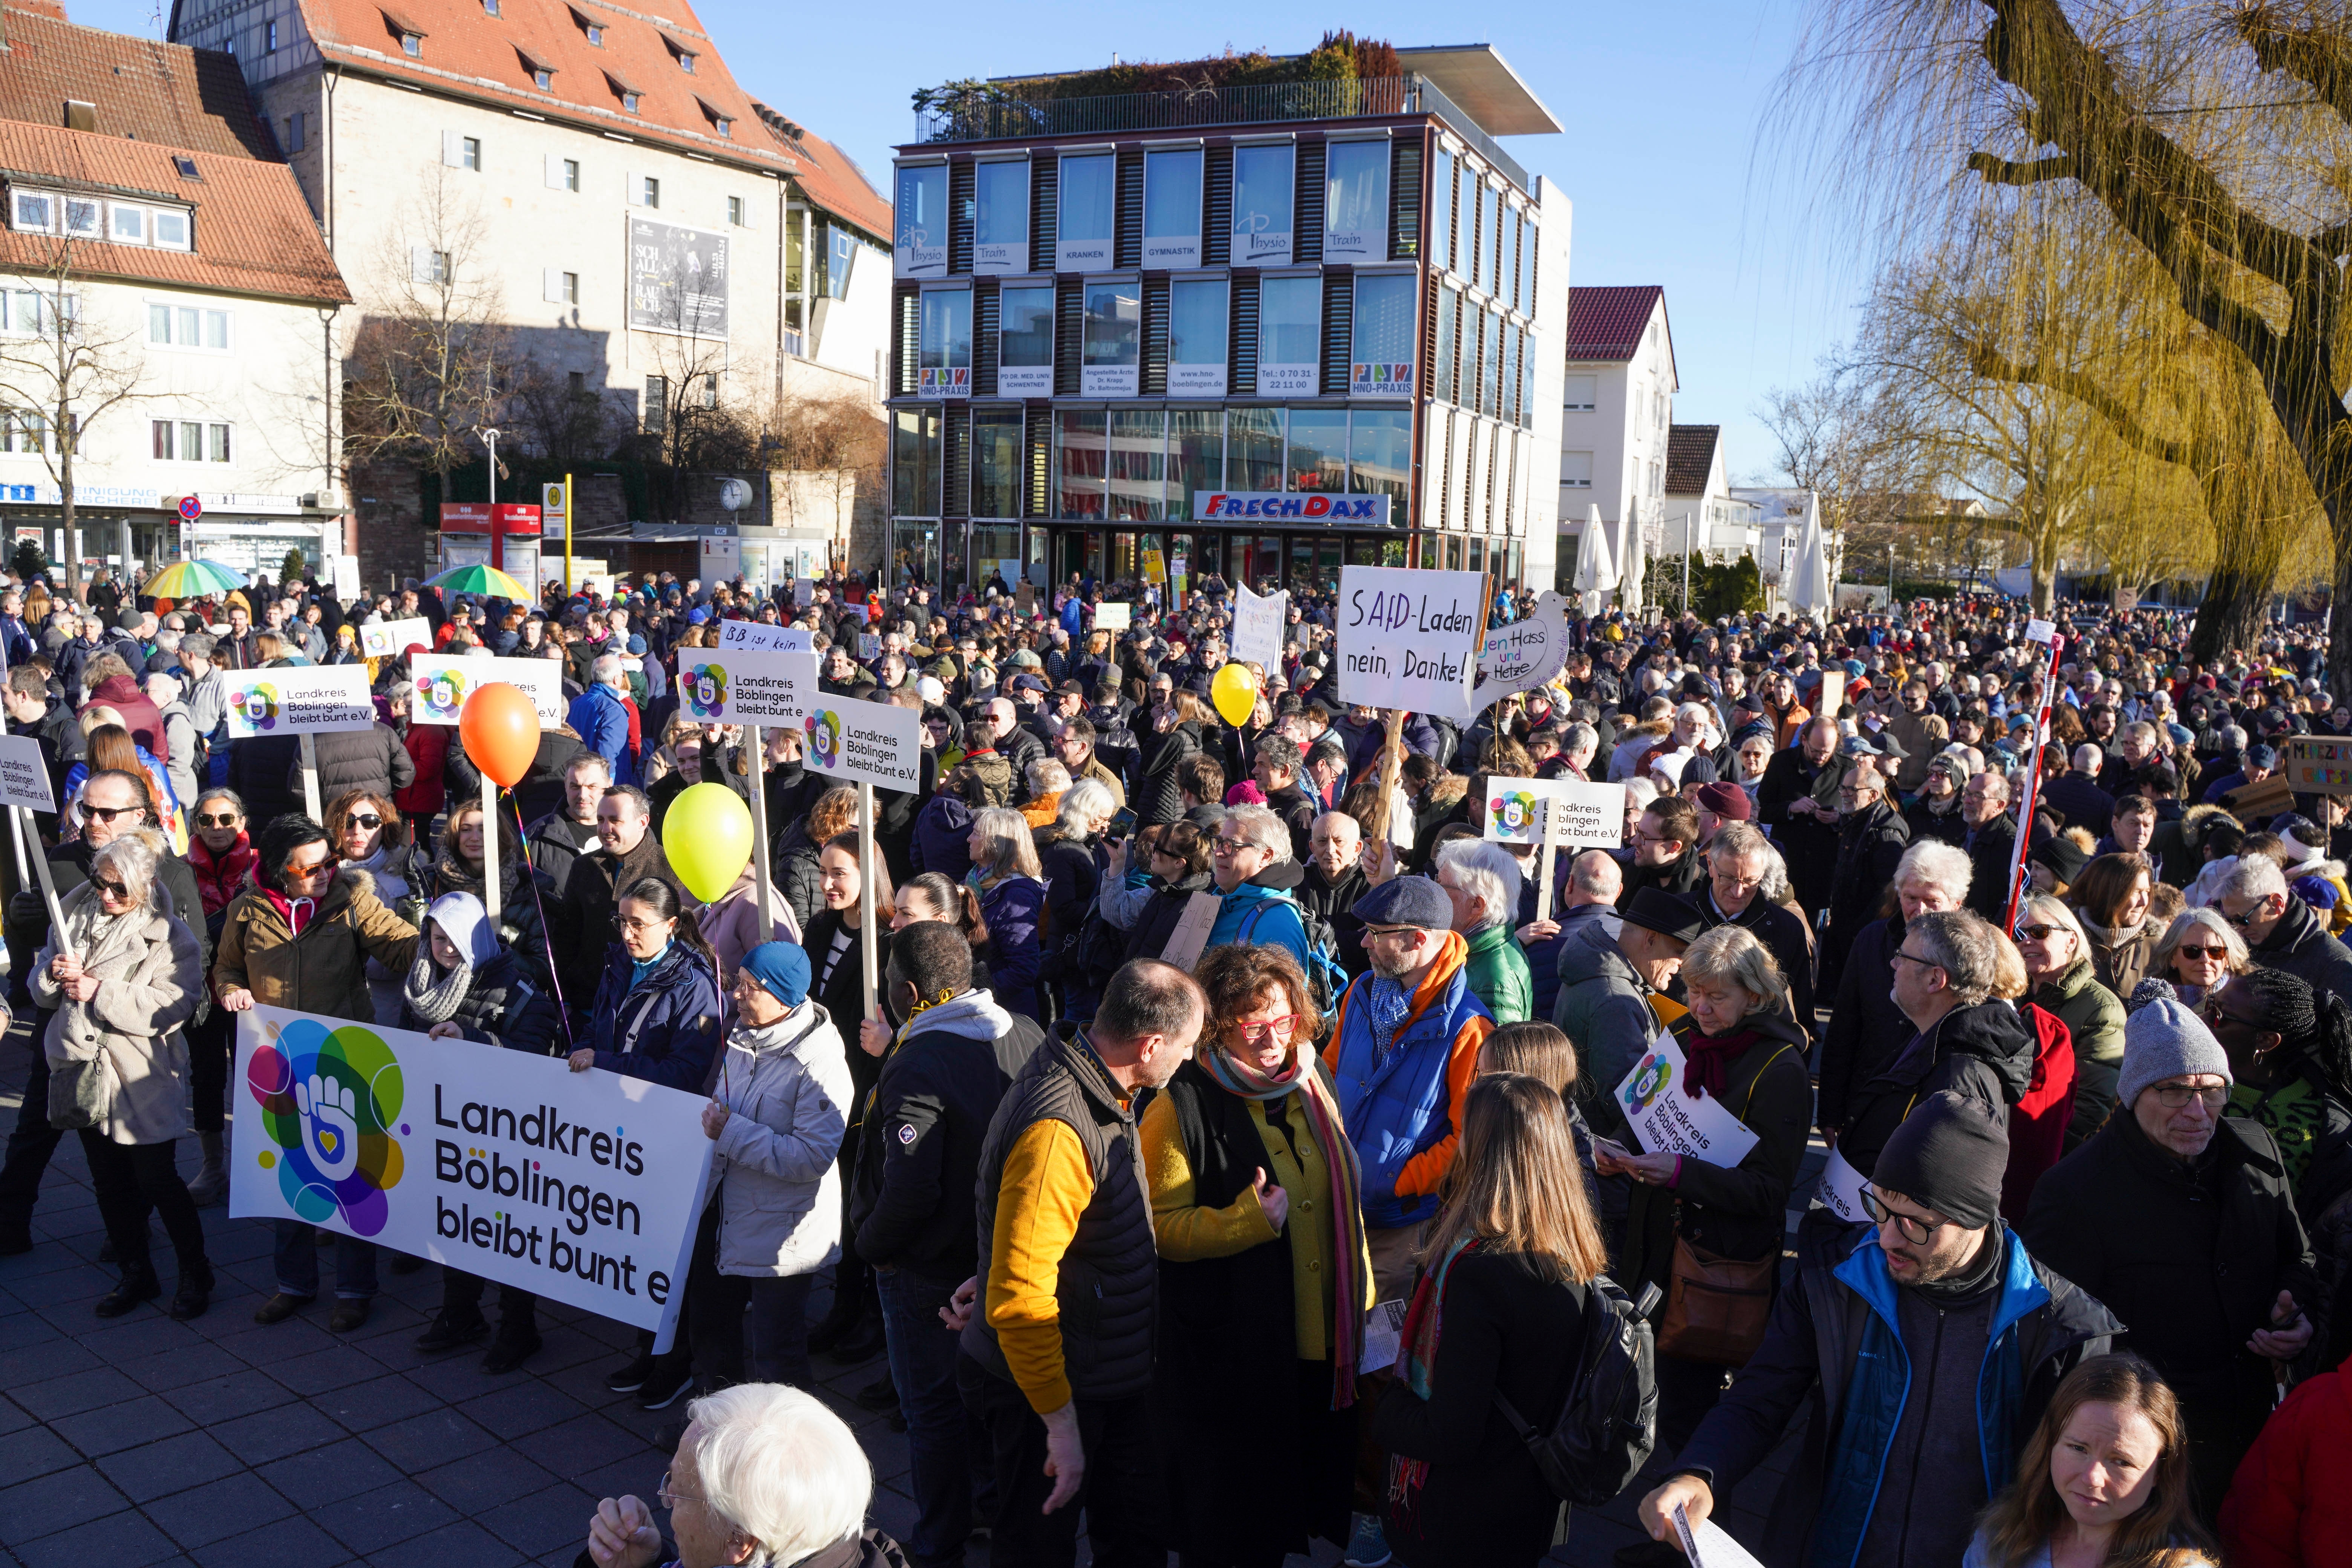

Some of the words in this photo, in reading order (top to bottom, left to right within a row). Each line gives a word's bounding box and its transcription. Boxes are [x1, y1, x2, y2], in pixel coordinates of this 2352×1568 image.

[1329, 233, 1362, 246] Train
[978, 246, 1006, 258] Train
[1148, 247, 1195, 256] GYMNASTIK
[920, 386, 969, 395] HNO-PRAXIS
[1353, 383, 1412, 393] HNO-PRAXIS
[59, 486, 157, 497] EINIGUNG
[726, 626, 747, 642] BB
[751, 635, 766, 645] ist
[773, 636, 796, 651] kein
[1478, 638, 1507, 658] gen
[1510, 628, 1545, 646] Hass
[1499, 648, 1521, 663] und
[1347, 646, 1391, 679] nein,
[1403, 649, 1467, 686] Danke!
[1494, 663, 1530, 679] Hetze
[1515, 675, 1548, 692] Friede
[1550, 664, 1562, 677] sei
[1559, 648, 1568, 662] mit
[736, 675, 793, 689] Landkreis
[287, 688, 346, 700] Landkreis
[736, 689, 793, 706] Böblingen
[288, 701, 348, 714] Böblingen
[538, 708, 557, 718] e.V.
[737, 703, 767, 715] bleibt
[769, 705, 793, 717] bunt
[289, 713, 322, 725] bleibt
[323, 712, 348, 724] bunt
[351, 710, 370, 722] e.V.
[847, 725, 897, 747] Landkreis
[847, 740, 897, 764] Böblingen
[0, 758, 32, 773] Landkreis
[847, 755, 873, 772] bleibt
[874, 762, 896, 778] bunt
[899, 767, 916, 781] e.V.
[3, 770, 35, 789] Böblingen
[6, 784, 25, 796] bleibt
[24, 787, 39, 799] bunt
[39, 791, 52, 802] e.V.
[1544, 801, 1601, 815] Lndkreis
[1543, 813, 1600, 828] Bblingen
[1542, 825, 1572, 836] bibt
[1574, 827, 1598, 837] bunt
[1601, 829, 1619, 838] e.V.
[1664, 1090, 1710, 1151] Landkreis
[435, 1084, 644, 1176] Landkreis
[1644, 1116, 1665, 1150] bleibt
[1654, 1103, 1699, 1159] Böblingen
[436, 1138, 640, 1236] Böblingen
[1821, 1175, 1851, 1217] andkreis
[437, 1196, 543, 1266] bleibt
[549, 1227, 637, 1295] bunt
[1395, 1312, 1403, 1327] wieder
